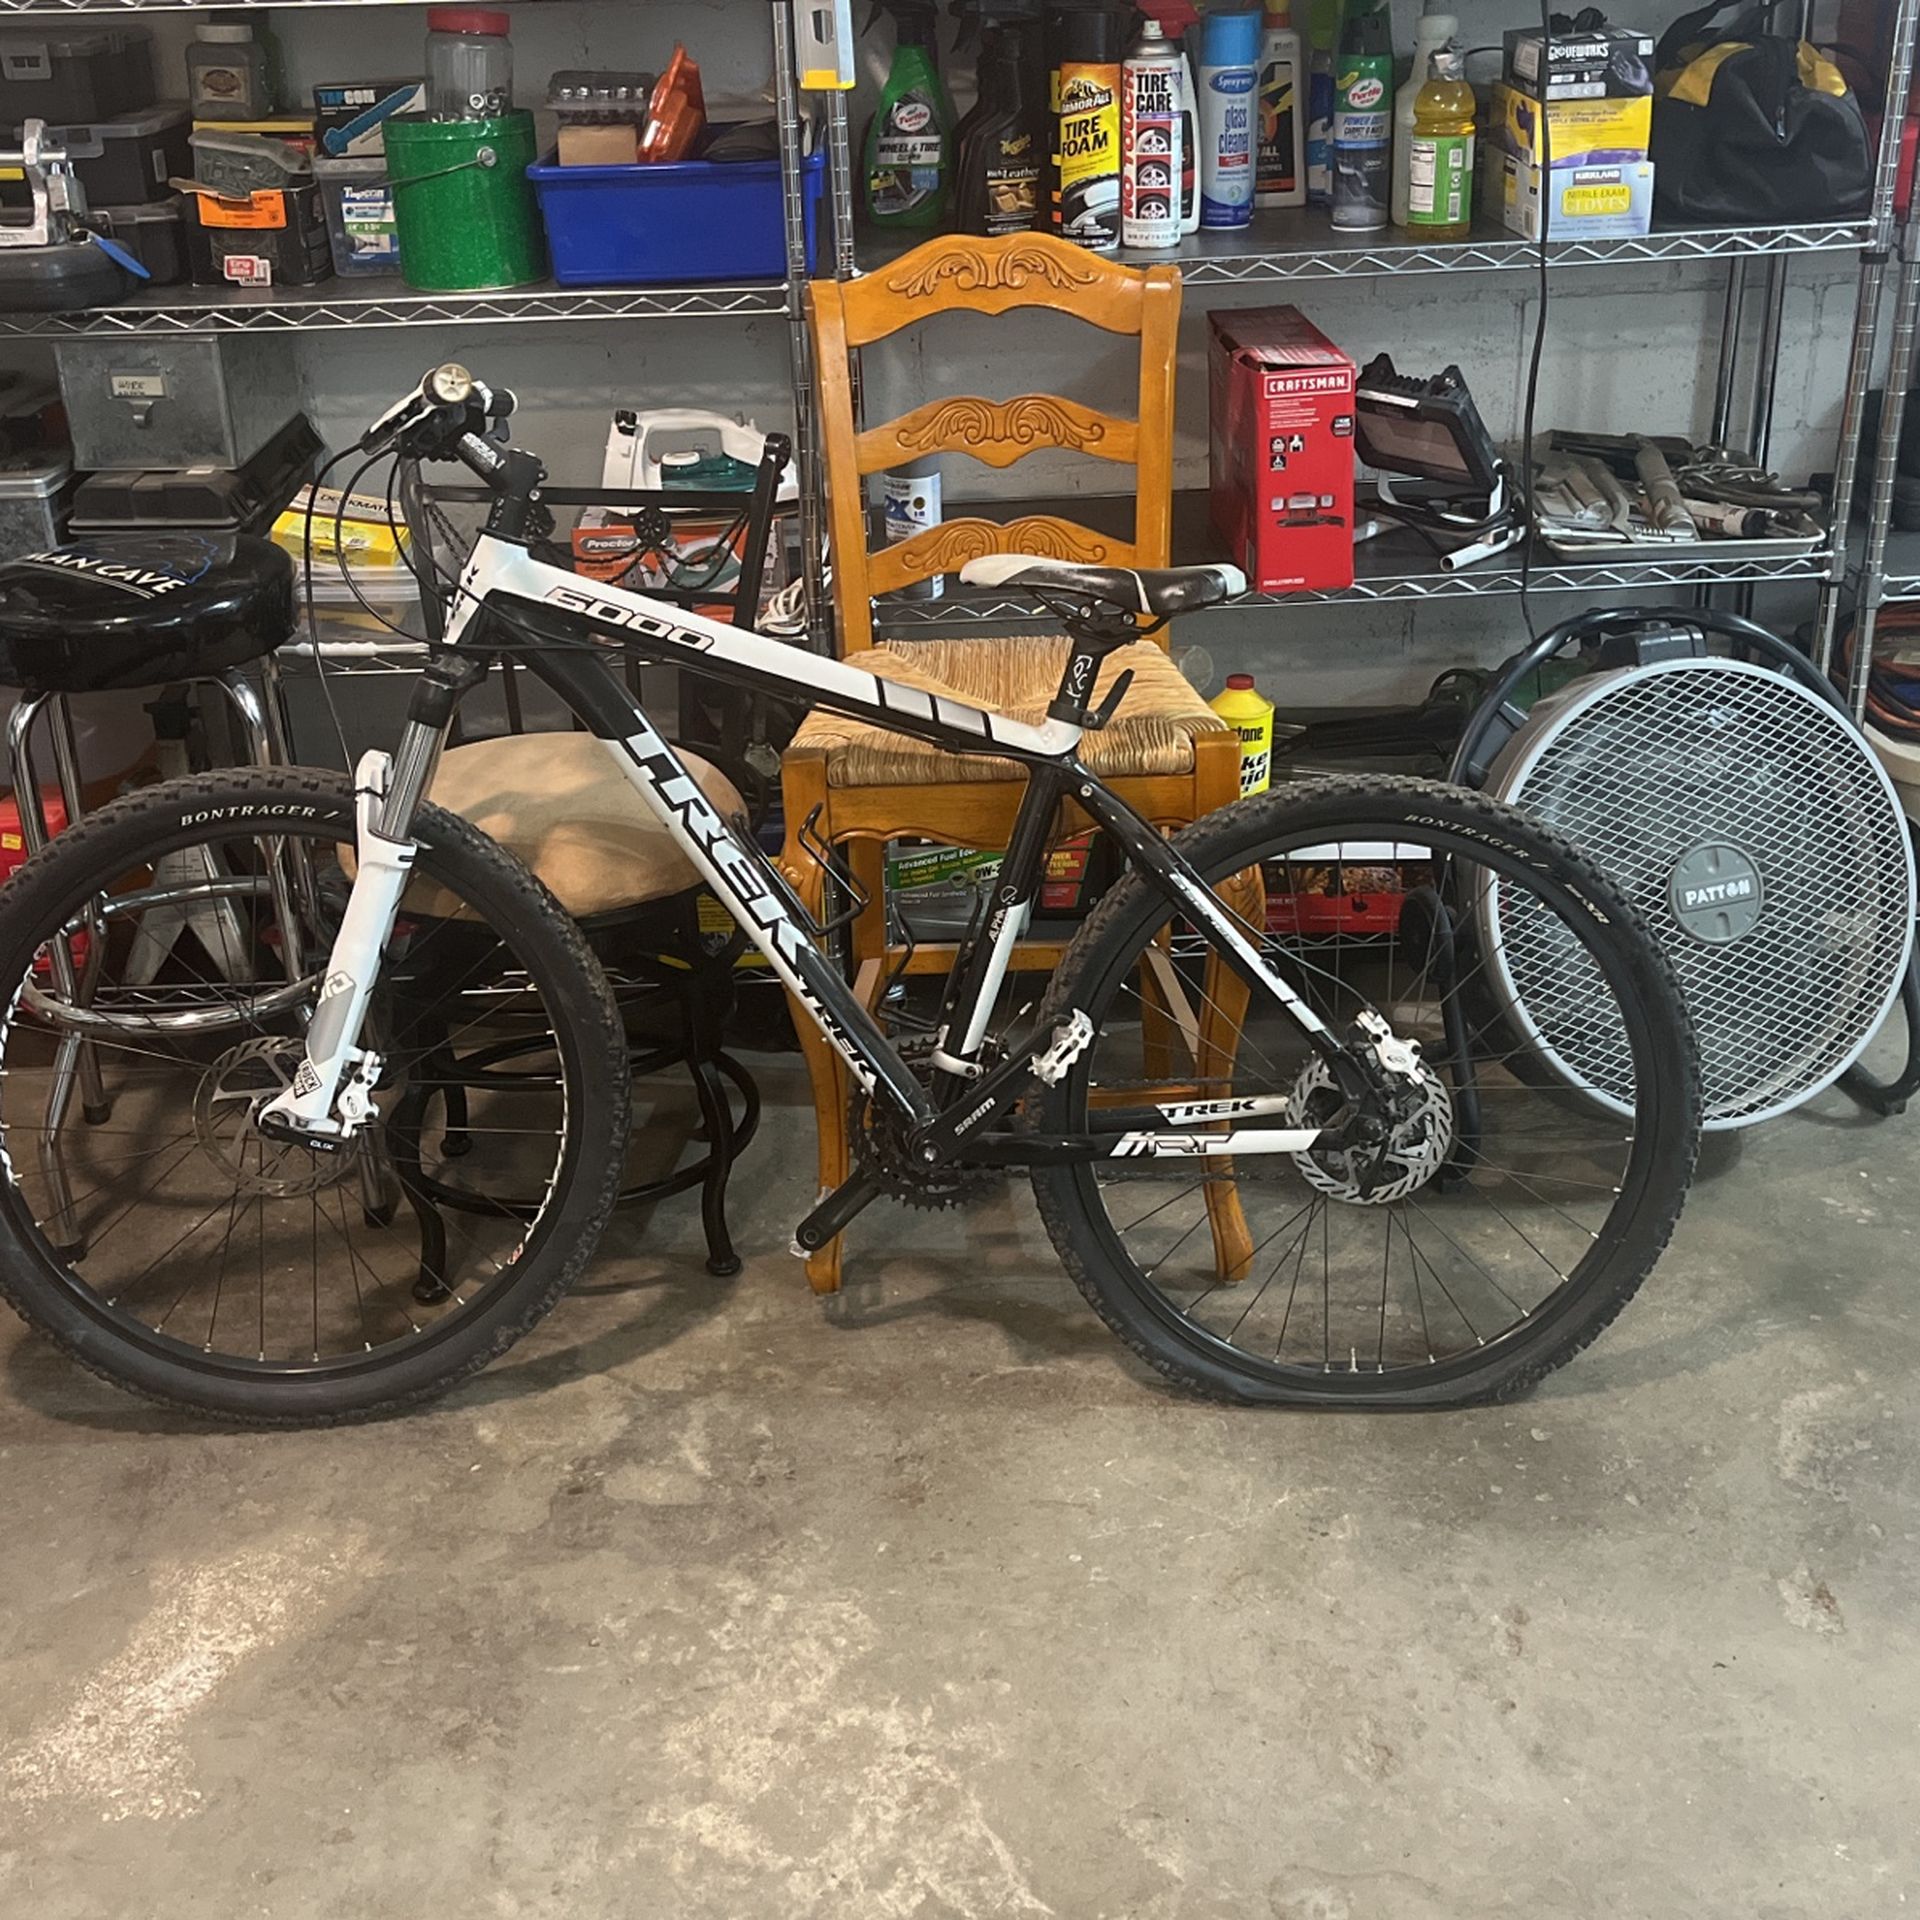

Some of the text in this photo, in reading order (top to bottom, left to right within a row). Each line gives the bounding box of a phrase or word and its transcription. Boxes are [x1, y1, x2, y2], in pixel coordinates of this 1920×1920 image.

[1136, 73, 1168, 93] TIRE
[1350, 86, 1382, 101] Turtle
[1136, 92, 1172, 112] CARE
[1065, 115, 1101, 140] TIRE
[1224, 105, 1248, 132] glass
[1062, 131, 1108, 158] FOAM
[1122, 67, 1134, 219] NO TOUCH
[1218, 132, 1250, 154] cleaner
[1575, 170, 1621, 180] KIRKLAND
[1567, 188, 1626, 199] NITRILE EXAM
[1564, 198, 1628, 212] GLOVES
[1269, 376, 1346, 393] CRAFTSMAN
[586, 537, 636, 549] Proctor
[95, 564, 187, 593] CAVE
[1241, 752, 1268, 771] ke
[180, 804, 316, 827] BONTRAGER
[625, 709, 819, 966] TREK
[1404, 814, 1530, 859] BONTRAGER
[898, 855, 939, 871] Advanced
[940, 850, 958, 862] Fuel
[1685, 879, 1751, 906] PATTON
[988, 908, 1007, 943] ALPHA
[1161, 1099, 1256, 1118] TREK
